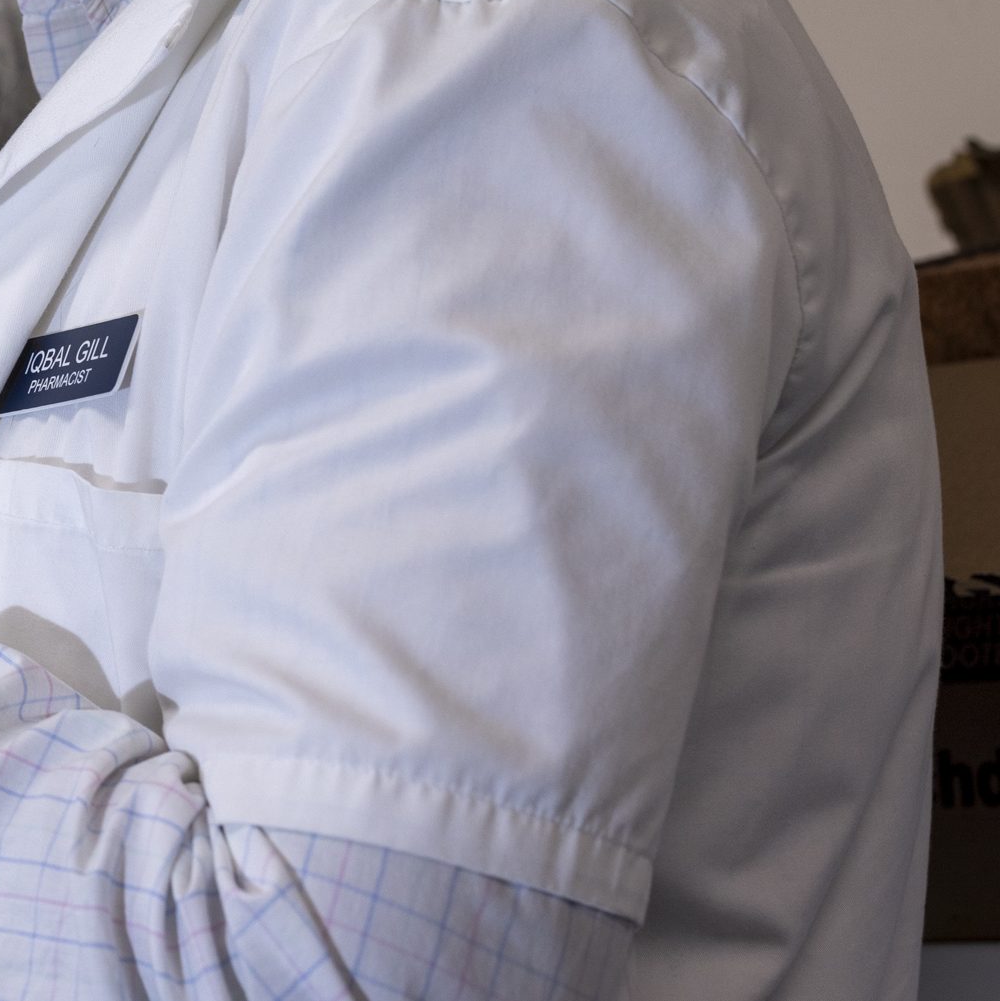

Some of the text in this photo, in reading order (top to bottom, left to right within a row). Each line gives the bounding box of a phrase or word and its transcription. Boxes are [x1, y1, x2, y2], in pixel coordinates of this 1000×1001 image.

[25, 335, 109, 375] IQBAL GILL
[27, 368, 92, 395] PHARMACIST
